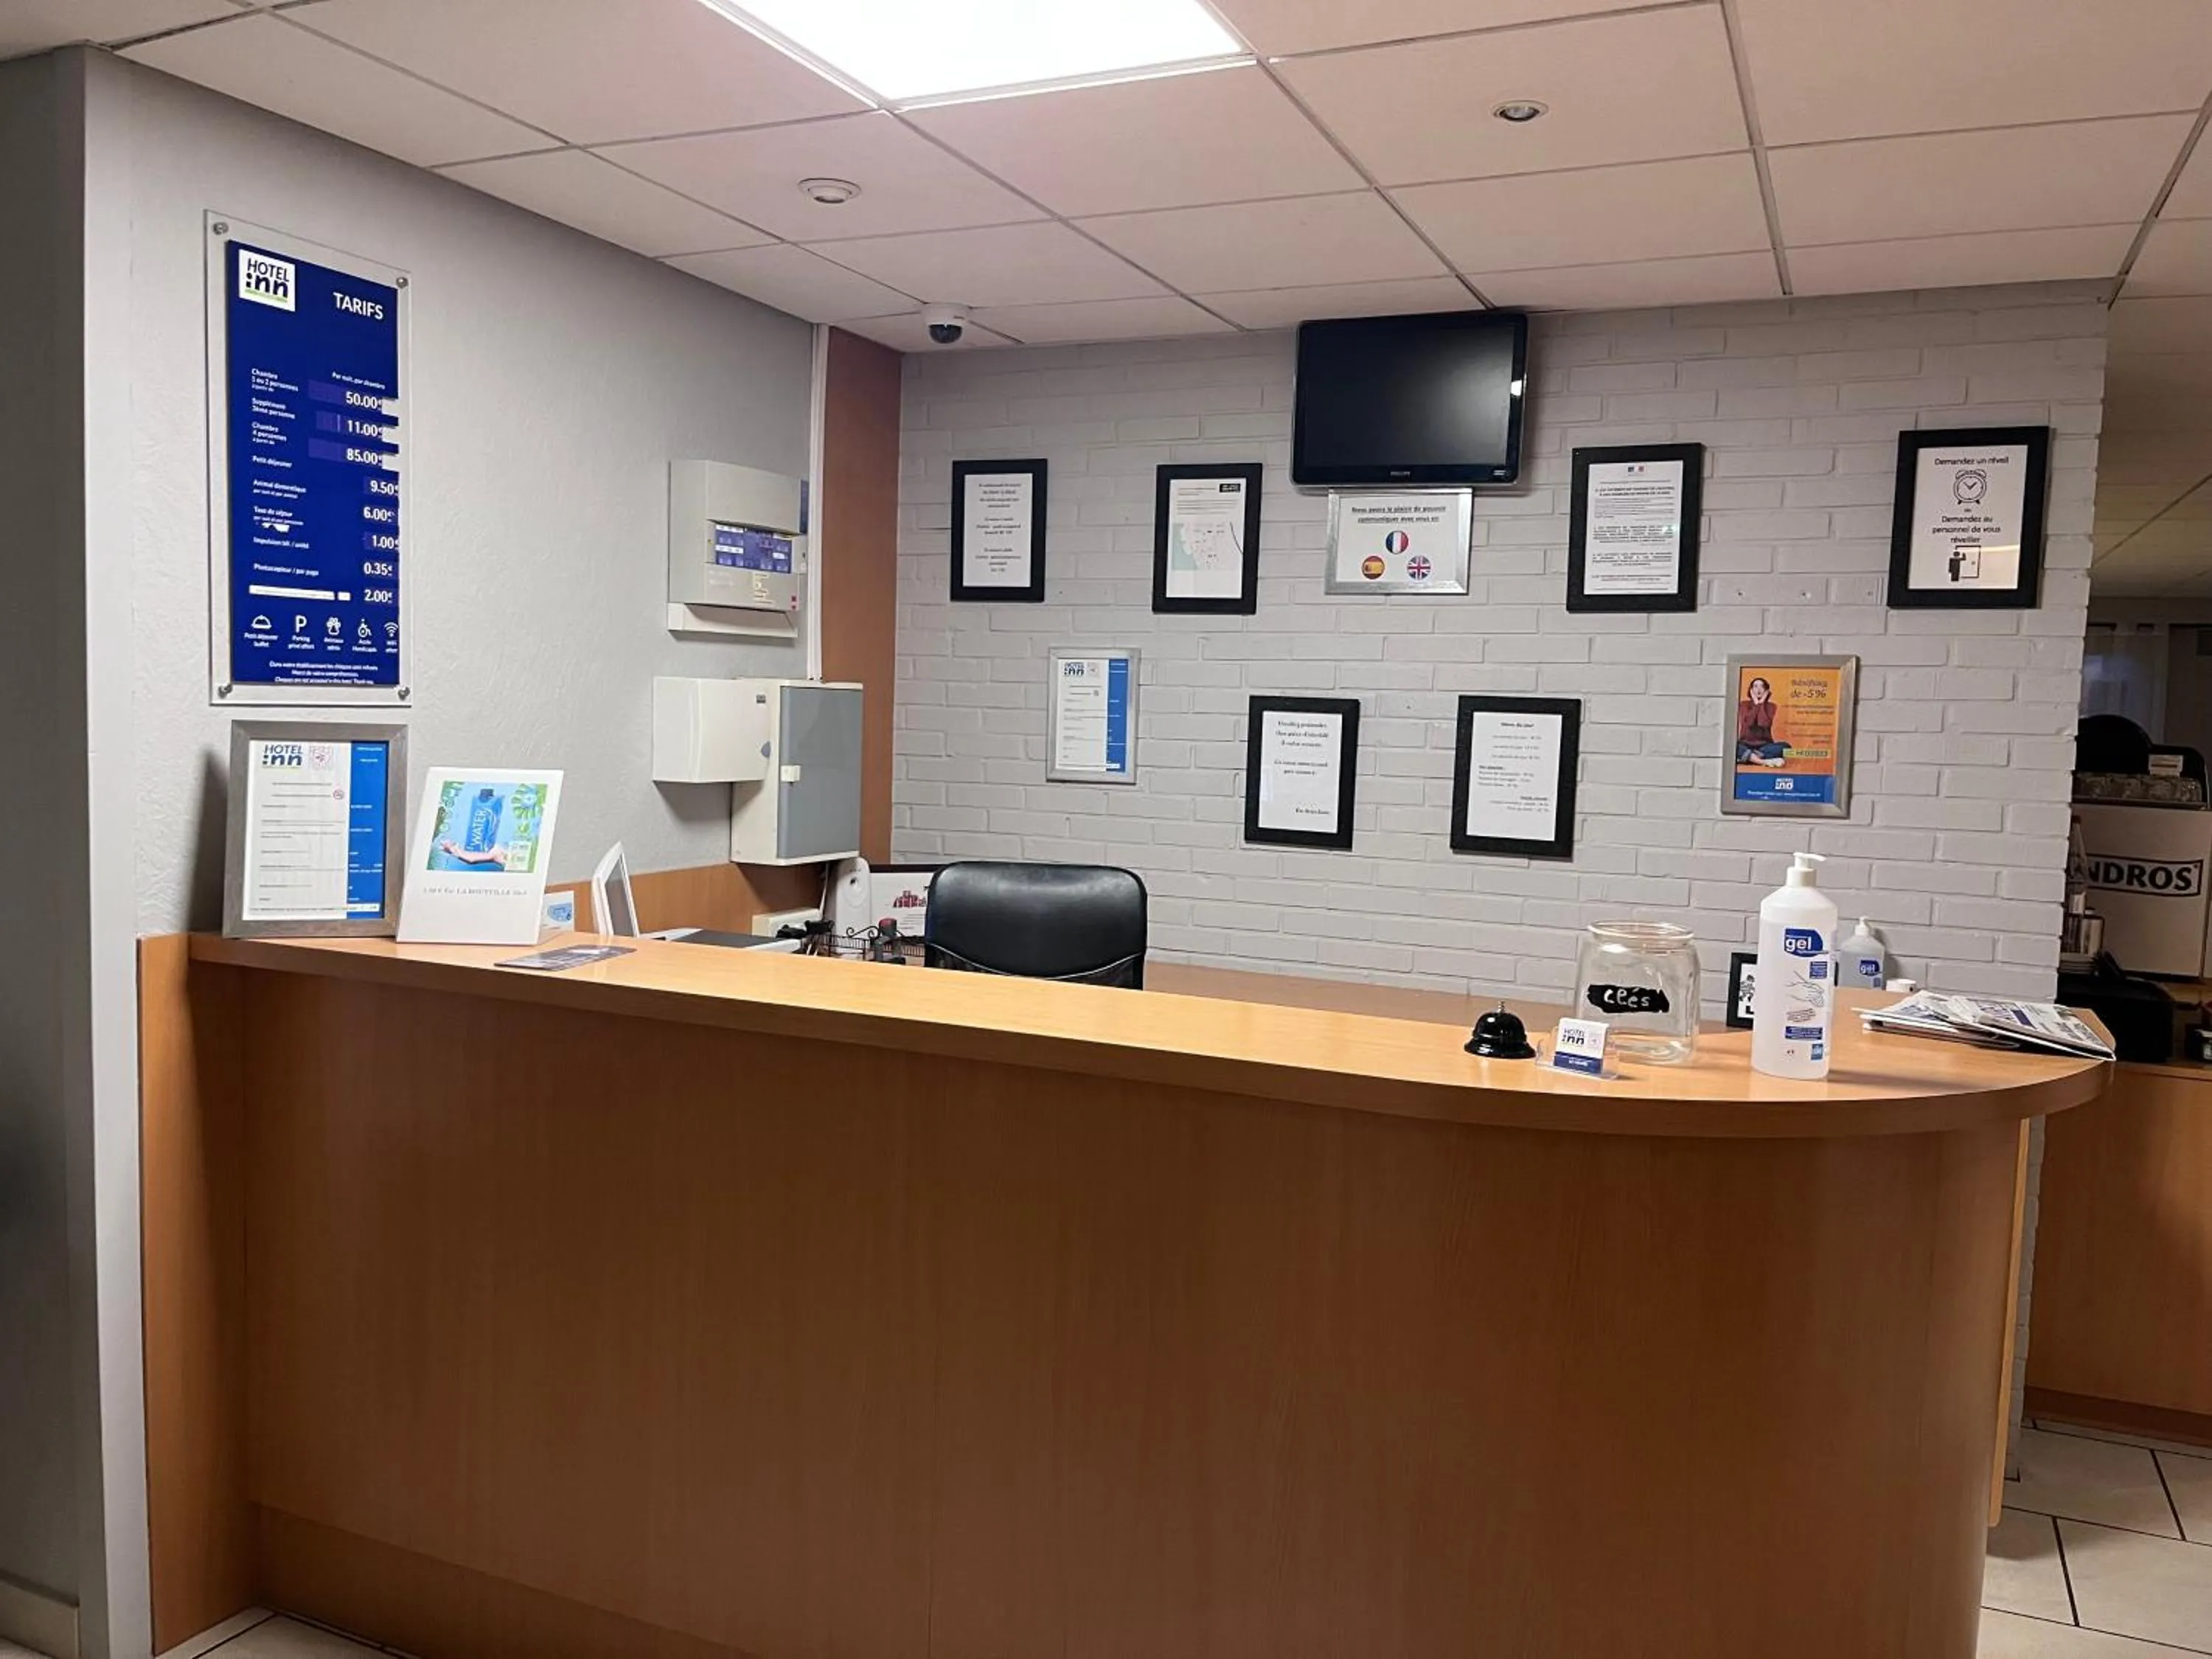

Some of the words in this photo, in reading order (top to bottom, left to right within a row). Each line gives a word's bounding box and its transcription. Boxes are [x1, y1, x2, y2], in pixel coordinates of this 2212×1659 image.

[247, 258, 290, 282] HOTEL
[333, 292, 383, 319] TARIFS
[1935, 457, 1975, 466] Demandez
[1932, 526, 1970, 534] personnel
[1971, 525, 1981, 533] de
[263, 744, 303, 754] HOTEL
[2086, 860, 2192, 891] NDROS
[1785, 936, 1812, 952] gel
[1860, 964, 1875, 974] gel
